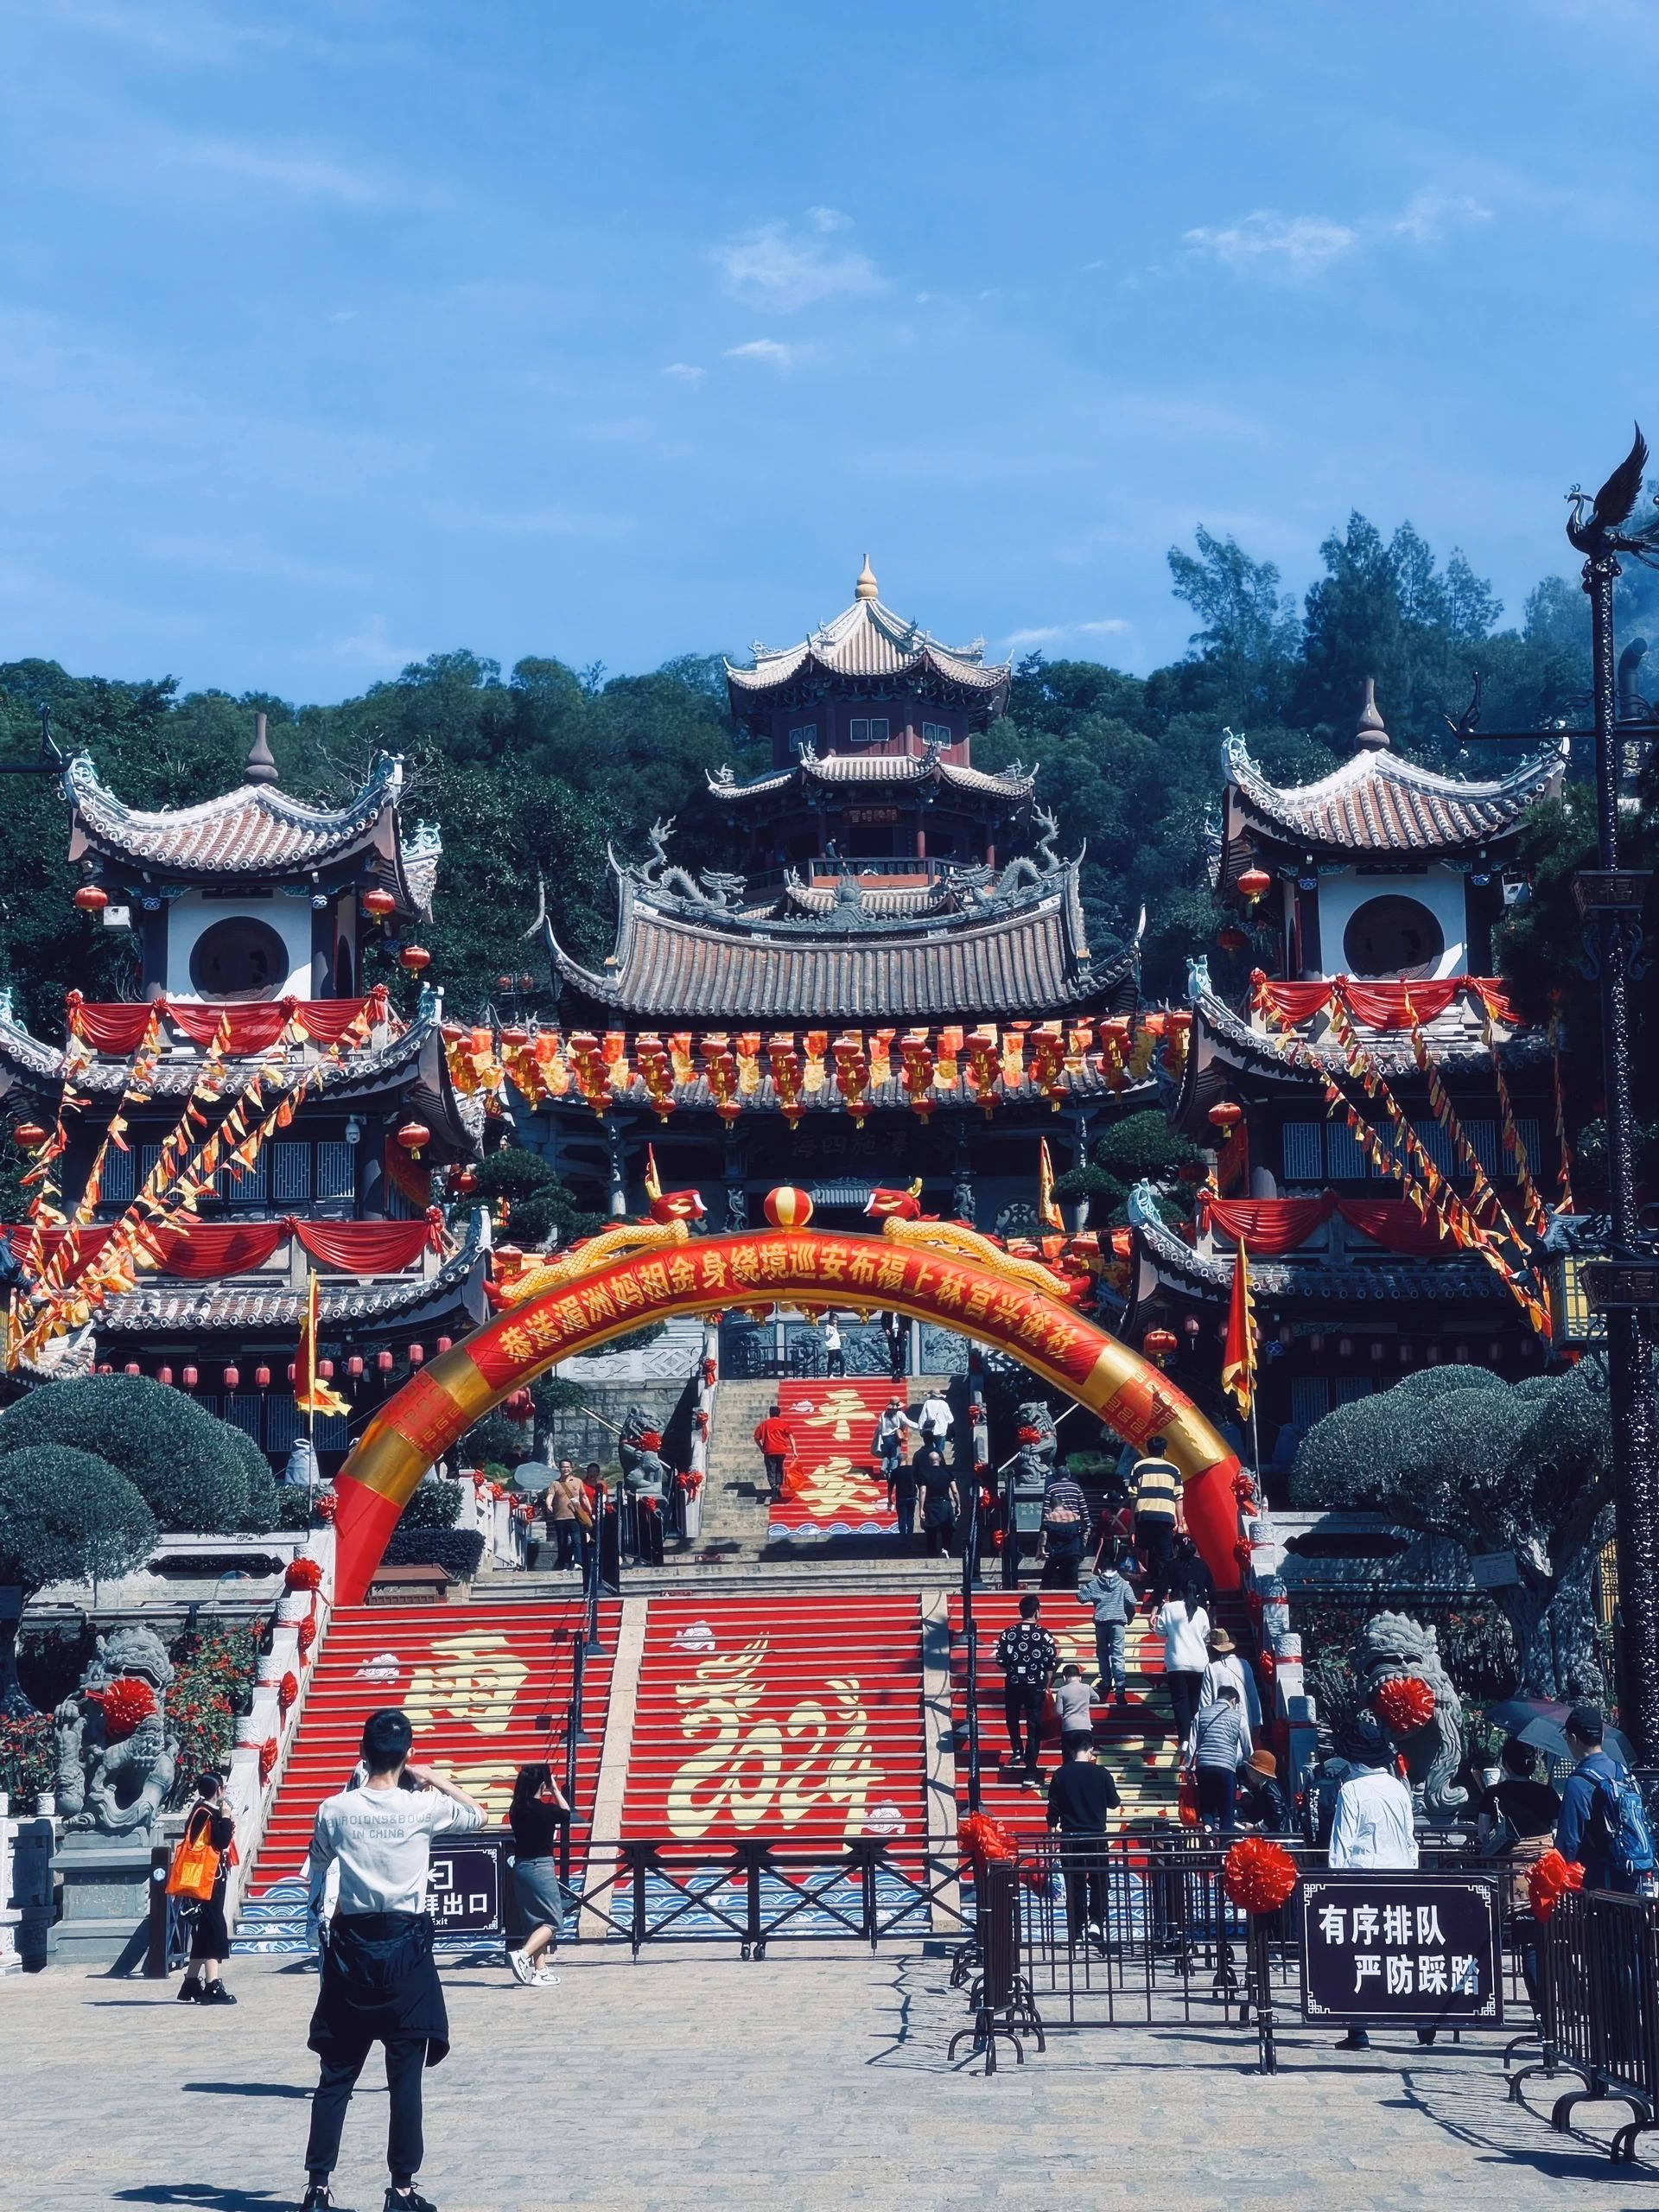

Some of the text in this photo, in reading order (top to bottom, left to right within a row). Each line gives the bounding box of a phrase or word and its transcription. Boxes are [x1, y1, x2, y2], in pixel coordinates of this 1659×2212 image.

[353, 1828, 404, 1840] IN CHINA
[1319, 1904, 1446, 1946] 有序排队
[1353, 1954, 1480, 1995] 严防踩踏
